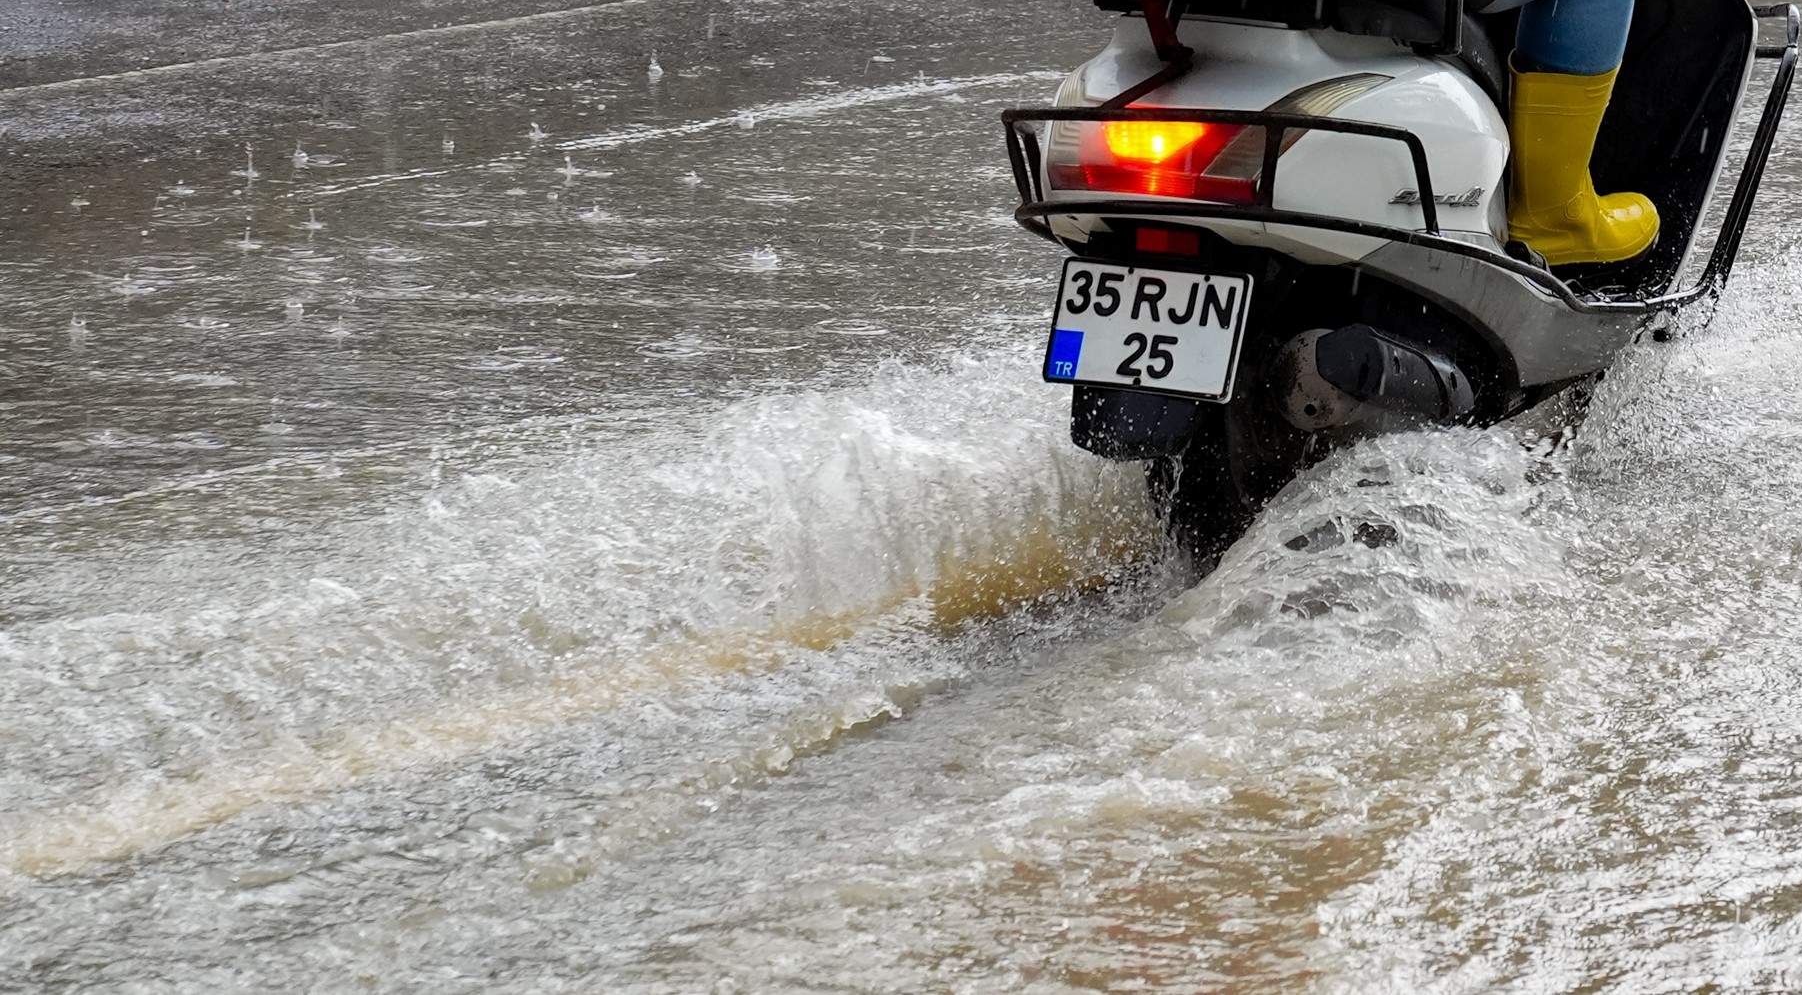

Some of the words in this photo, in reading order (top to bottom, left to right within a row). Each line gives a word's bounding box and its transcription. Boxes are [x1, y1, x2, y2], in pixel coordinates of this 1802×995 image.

[1066, 270, 1125, 317] 35
[1130, 276, 1237, 330] RJN
[1054, 361, 1073, 376] TR
[1116, 332, 1178, 380] 25
